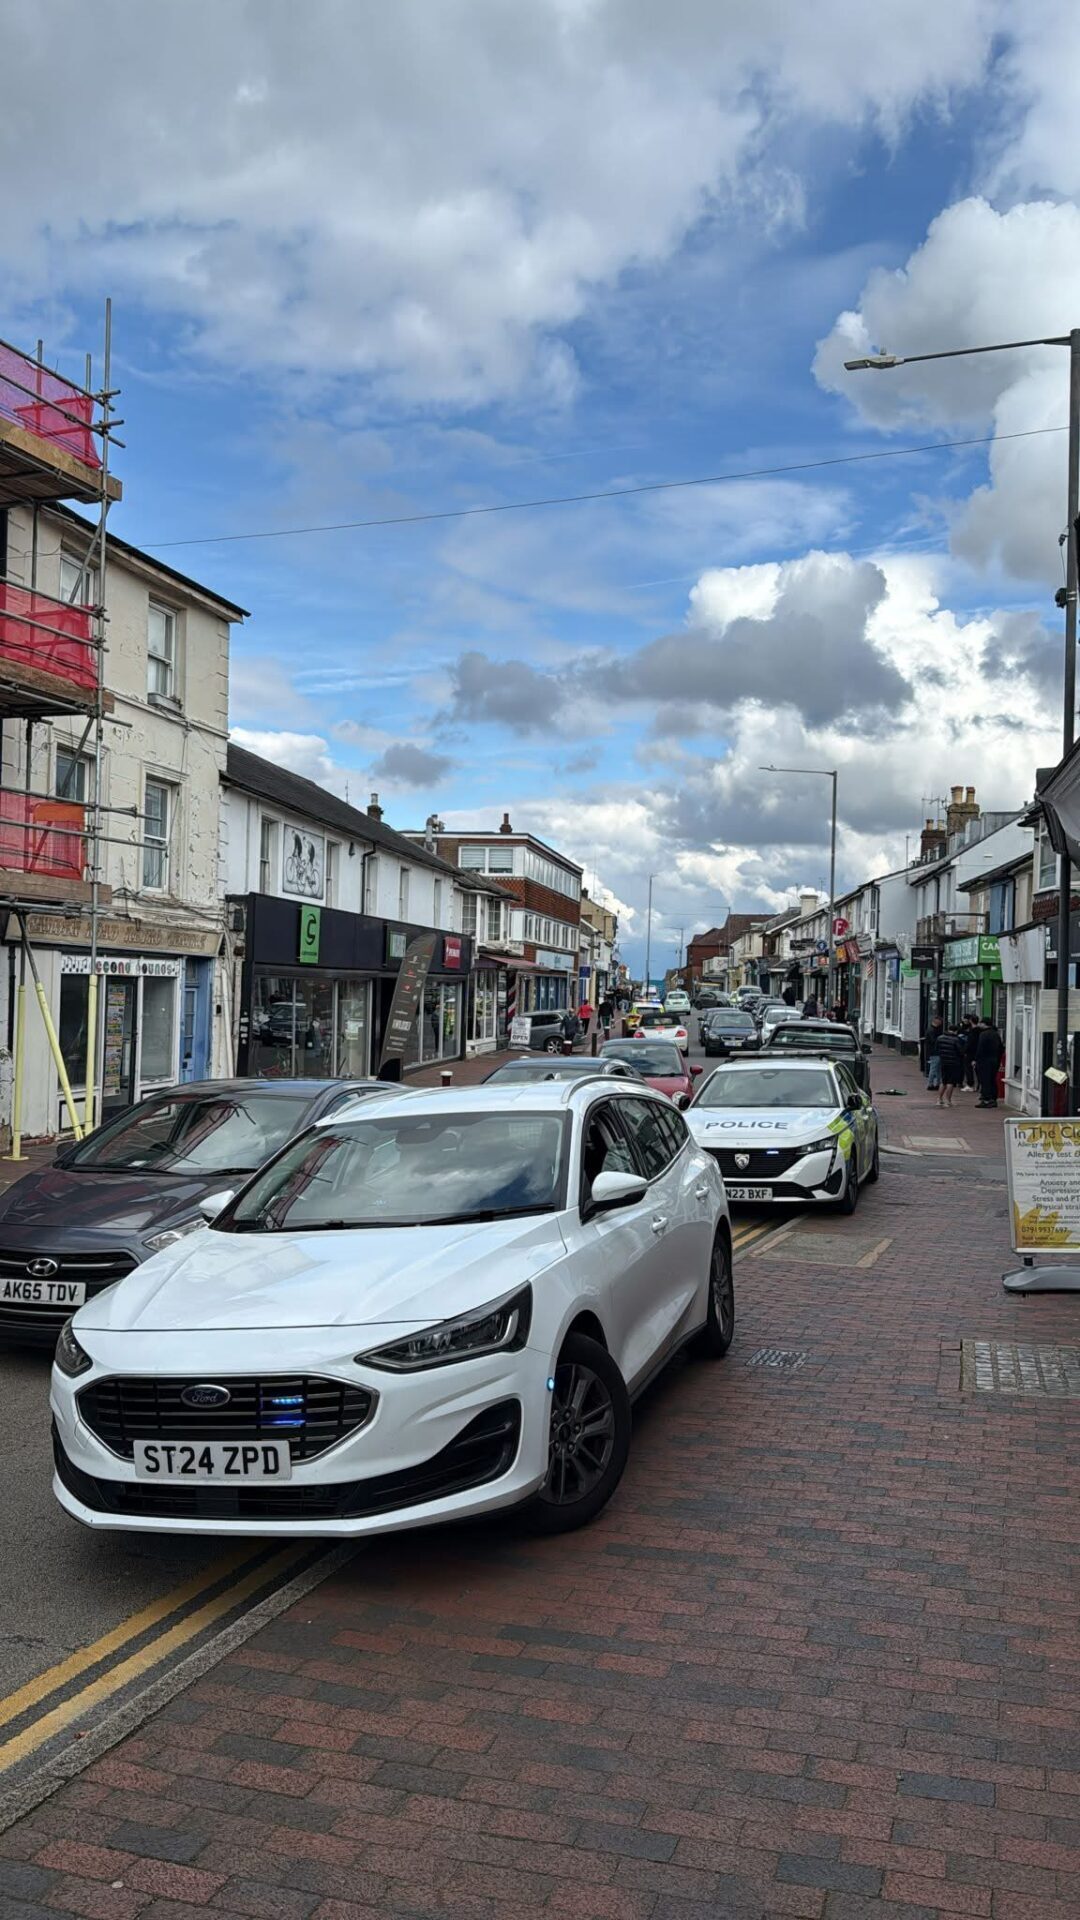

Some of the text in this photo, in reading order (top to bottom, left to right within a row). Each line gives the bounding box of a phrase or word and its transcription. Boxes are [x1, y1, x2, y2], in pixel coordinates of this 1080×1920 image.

[705, 1121, 788, 1130] POLICE
[1014, 1127, 1026, 1139] In
[1028, 1127, 1056, 1139] The
[1027, 1151, 1054, 1160] Allergy
[1040, 1179, 1067, 1187] Anxiety
[748, 1189, 768, 1199] BXF
[3, 1281, 77, 1302] AK65 TDV
[191, 1390, 218, 1402] Ford
[143, 1445, 280, 1474] ST24 ZPD
